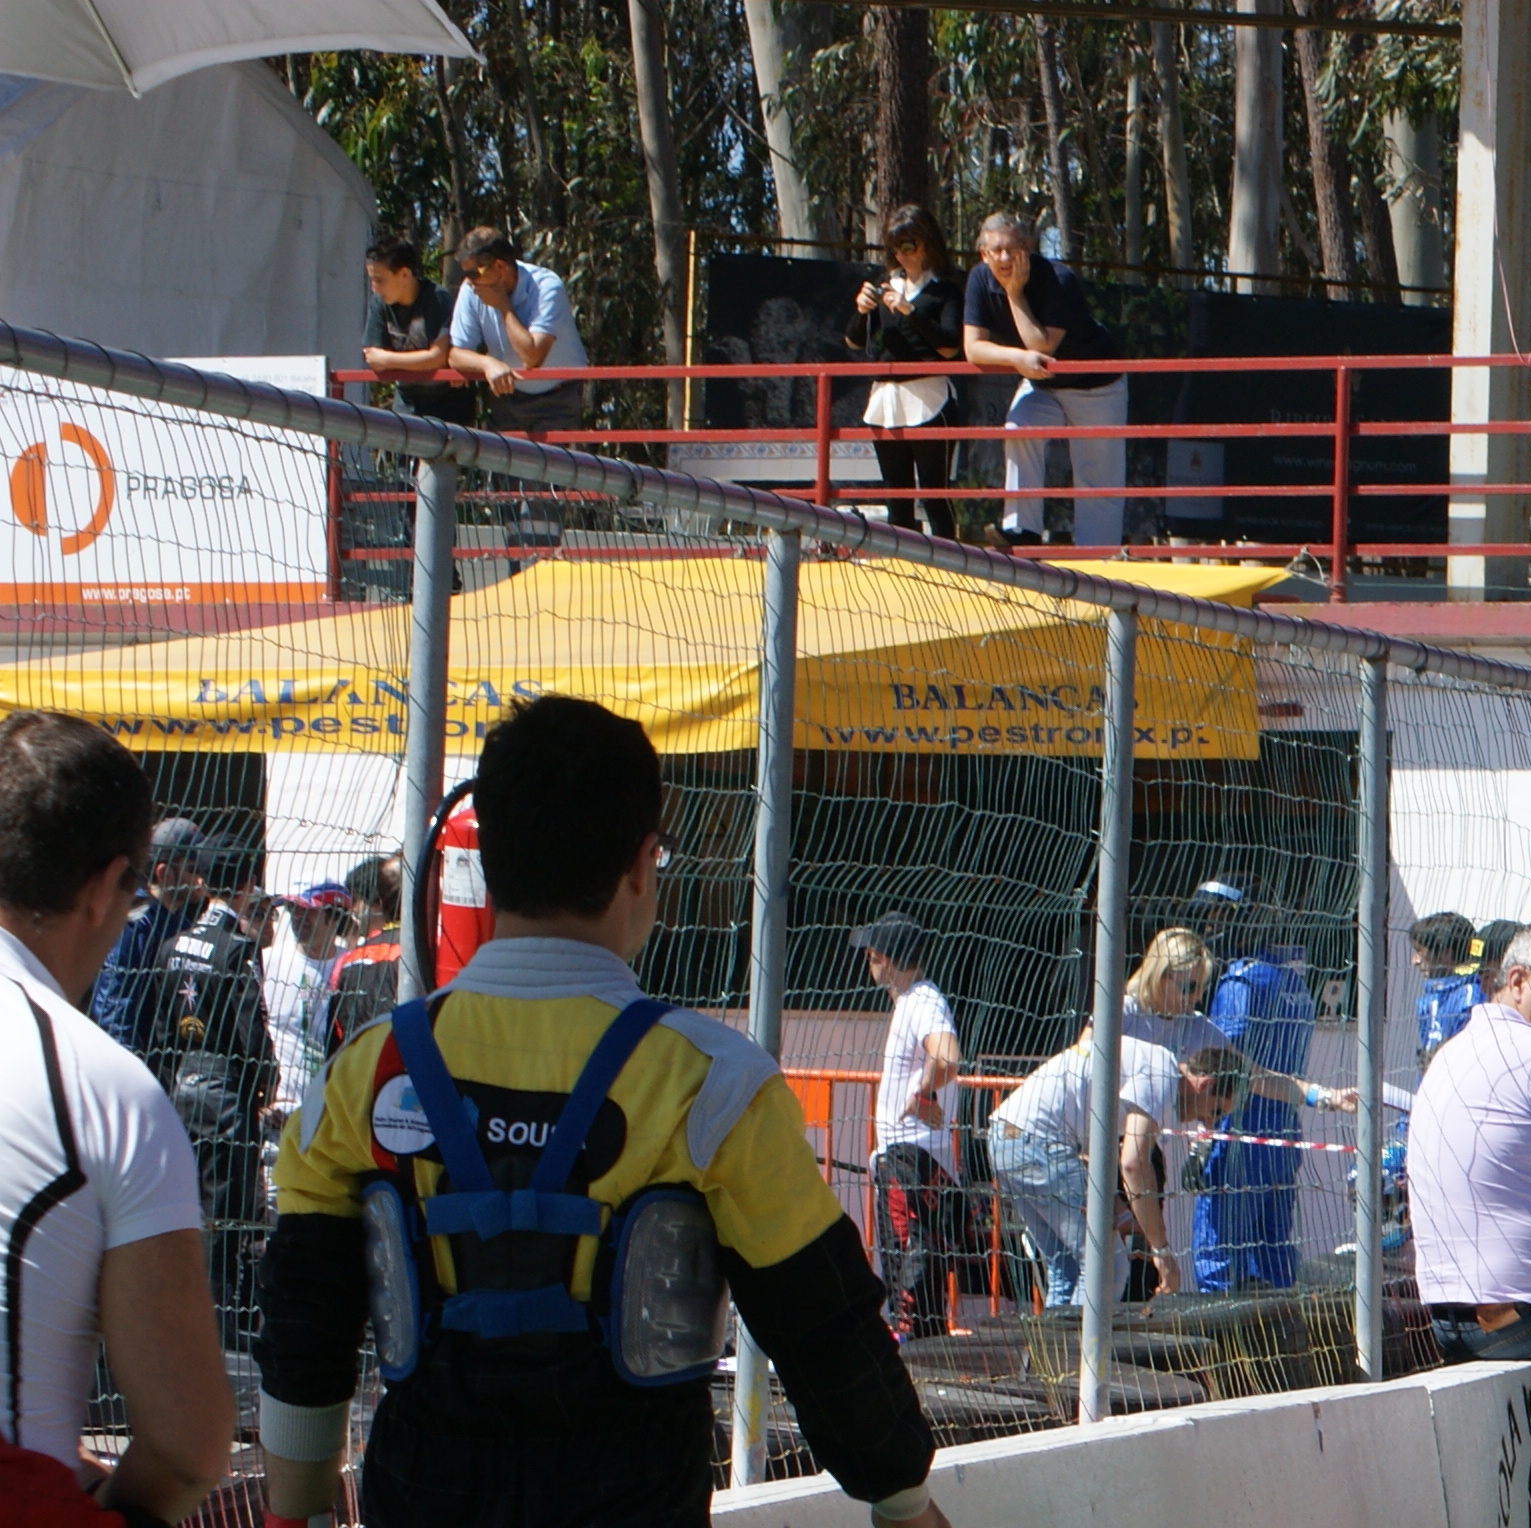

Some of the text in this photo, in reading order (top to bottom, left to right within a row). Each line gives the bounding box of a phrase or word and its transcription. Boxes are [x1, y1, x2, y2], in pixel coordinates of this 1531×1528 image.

[126, 474, 254, 501] PRAGOSA
[194, 677, 543, 706] BALANAS
[892, 683, 1141, 717] BALANÇA
